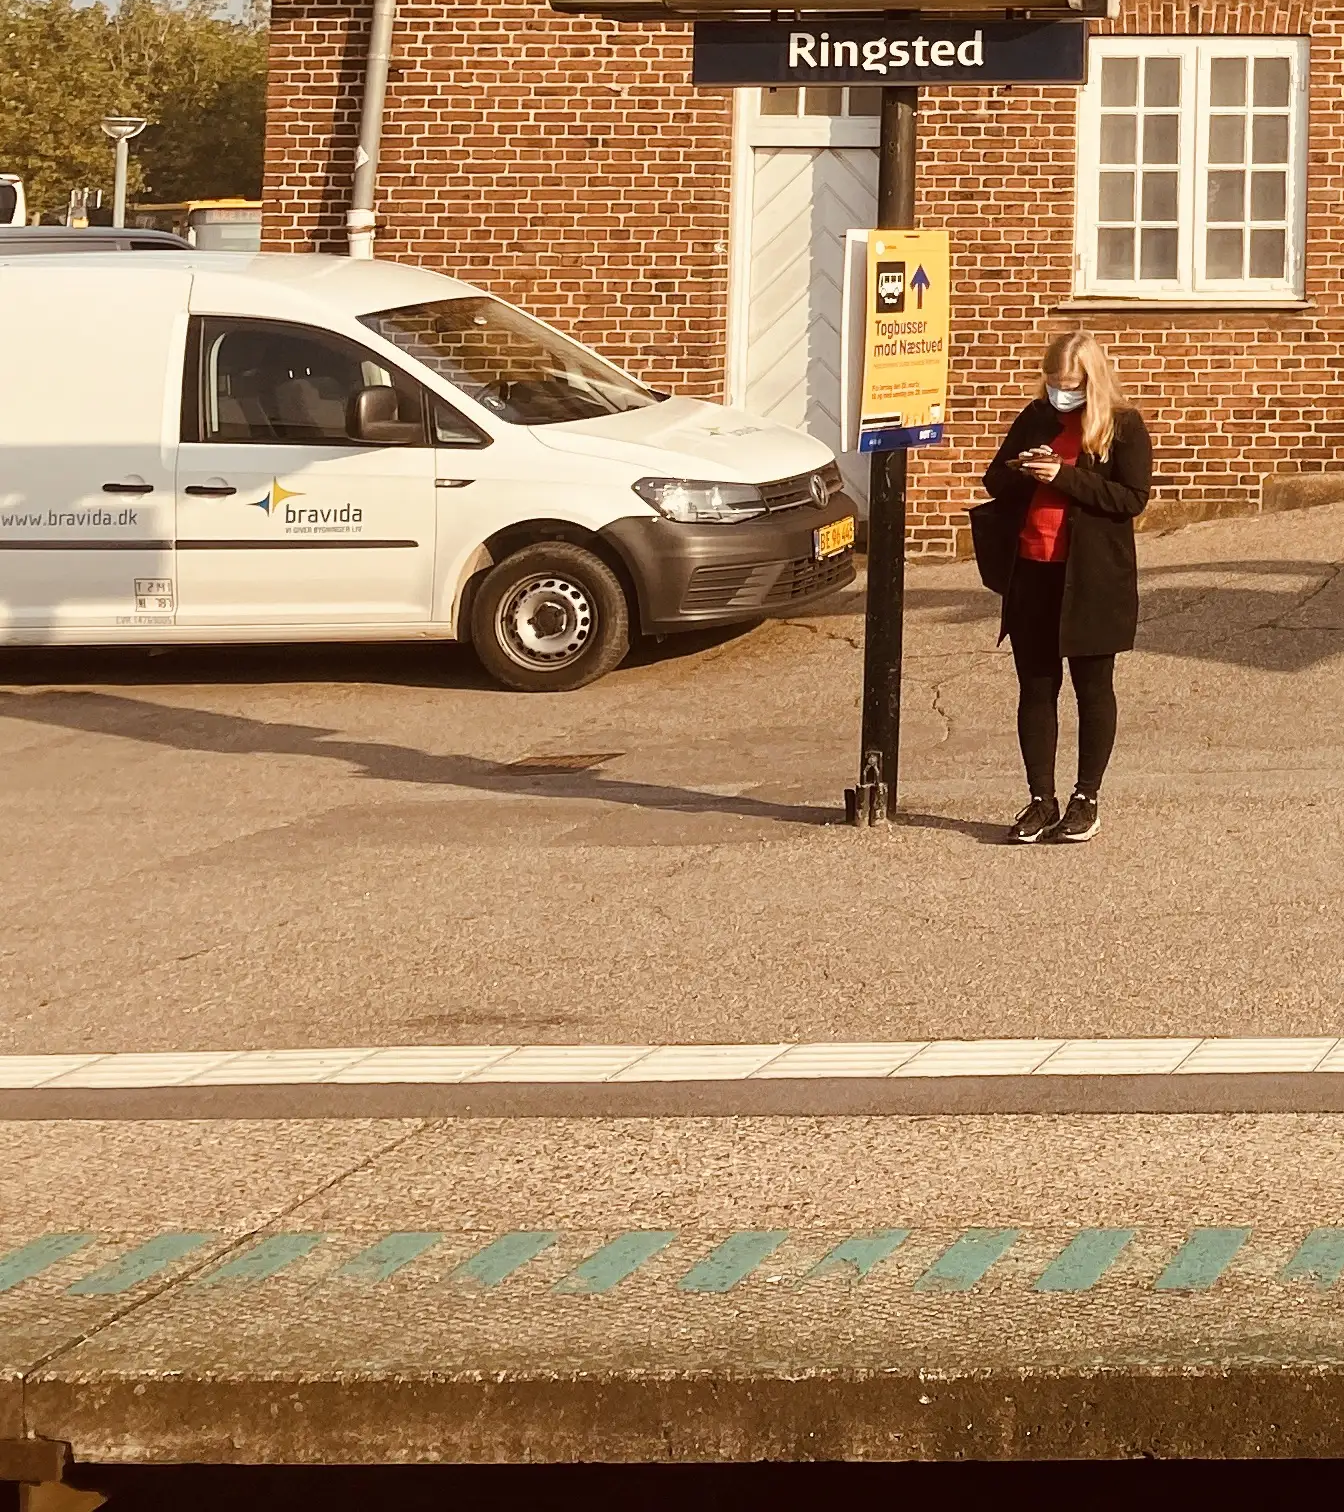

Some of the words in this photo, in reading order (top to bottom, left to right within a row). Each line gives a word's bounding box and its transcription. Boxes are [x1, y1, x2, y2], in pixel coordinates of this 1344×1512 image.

[788, 29, 985, 75] Ringsted
[875, 319, 928, 340] Togbusser
[873, 339, 898, 357] mod
[899, 336, 943, 356] Næstved
[1, 509, 138, 526] www.bravida.dk
[285, 503, 363, 523] bravida
